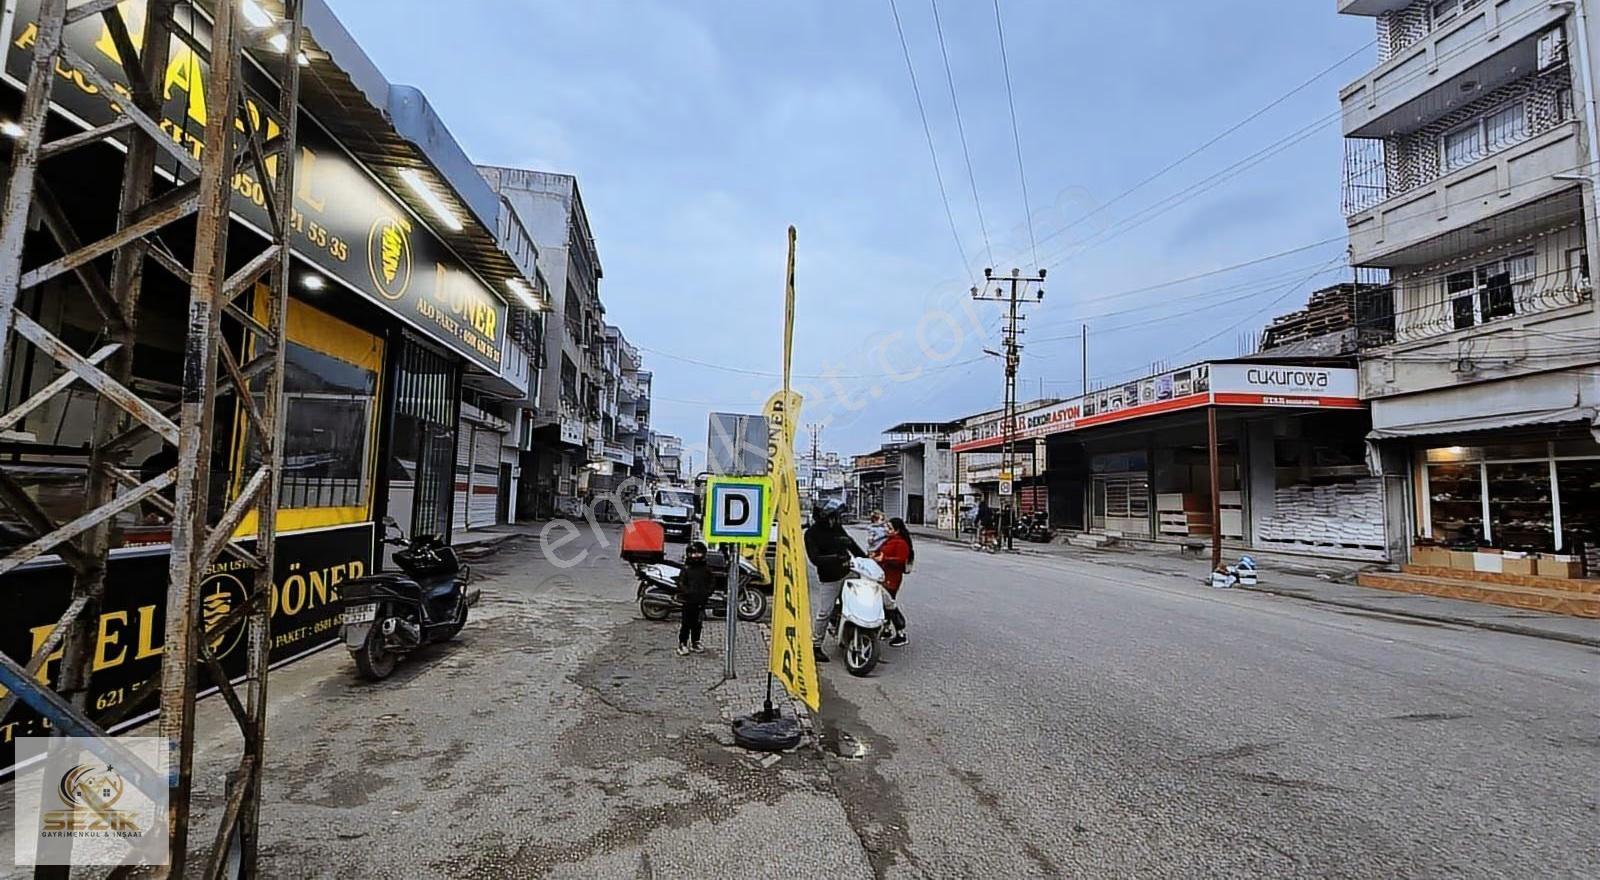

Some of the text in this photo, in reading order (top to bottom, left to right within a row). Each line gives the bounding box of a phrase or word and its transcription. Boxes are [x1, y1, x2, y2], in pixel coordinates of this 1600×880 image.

[308, 221, 327, 248] 55
[330, 236, 349, 262] 35
[724, 493, 750, 527] D
[96, 687, 125, 711] 621
